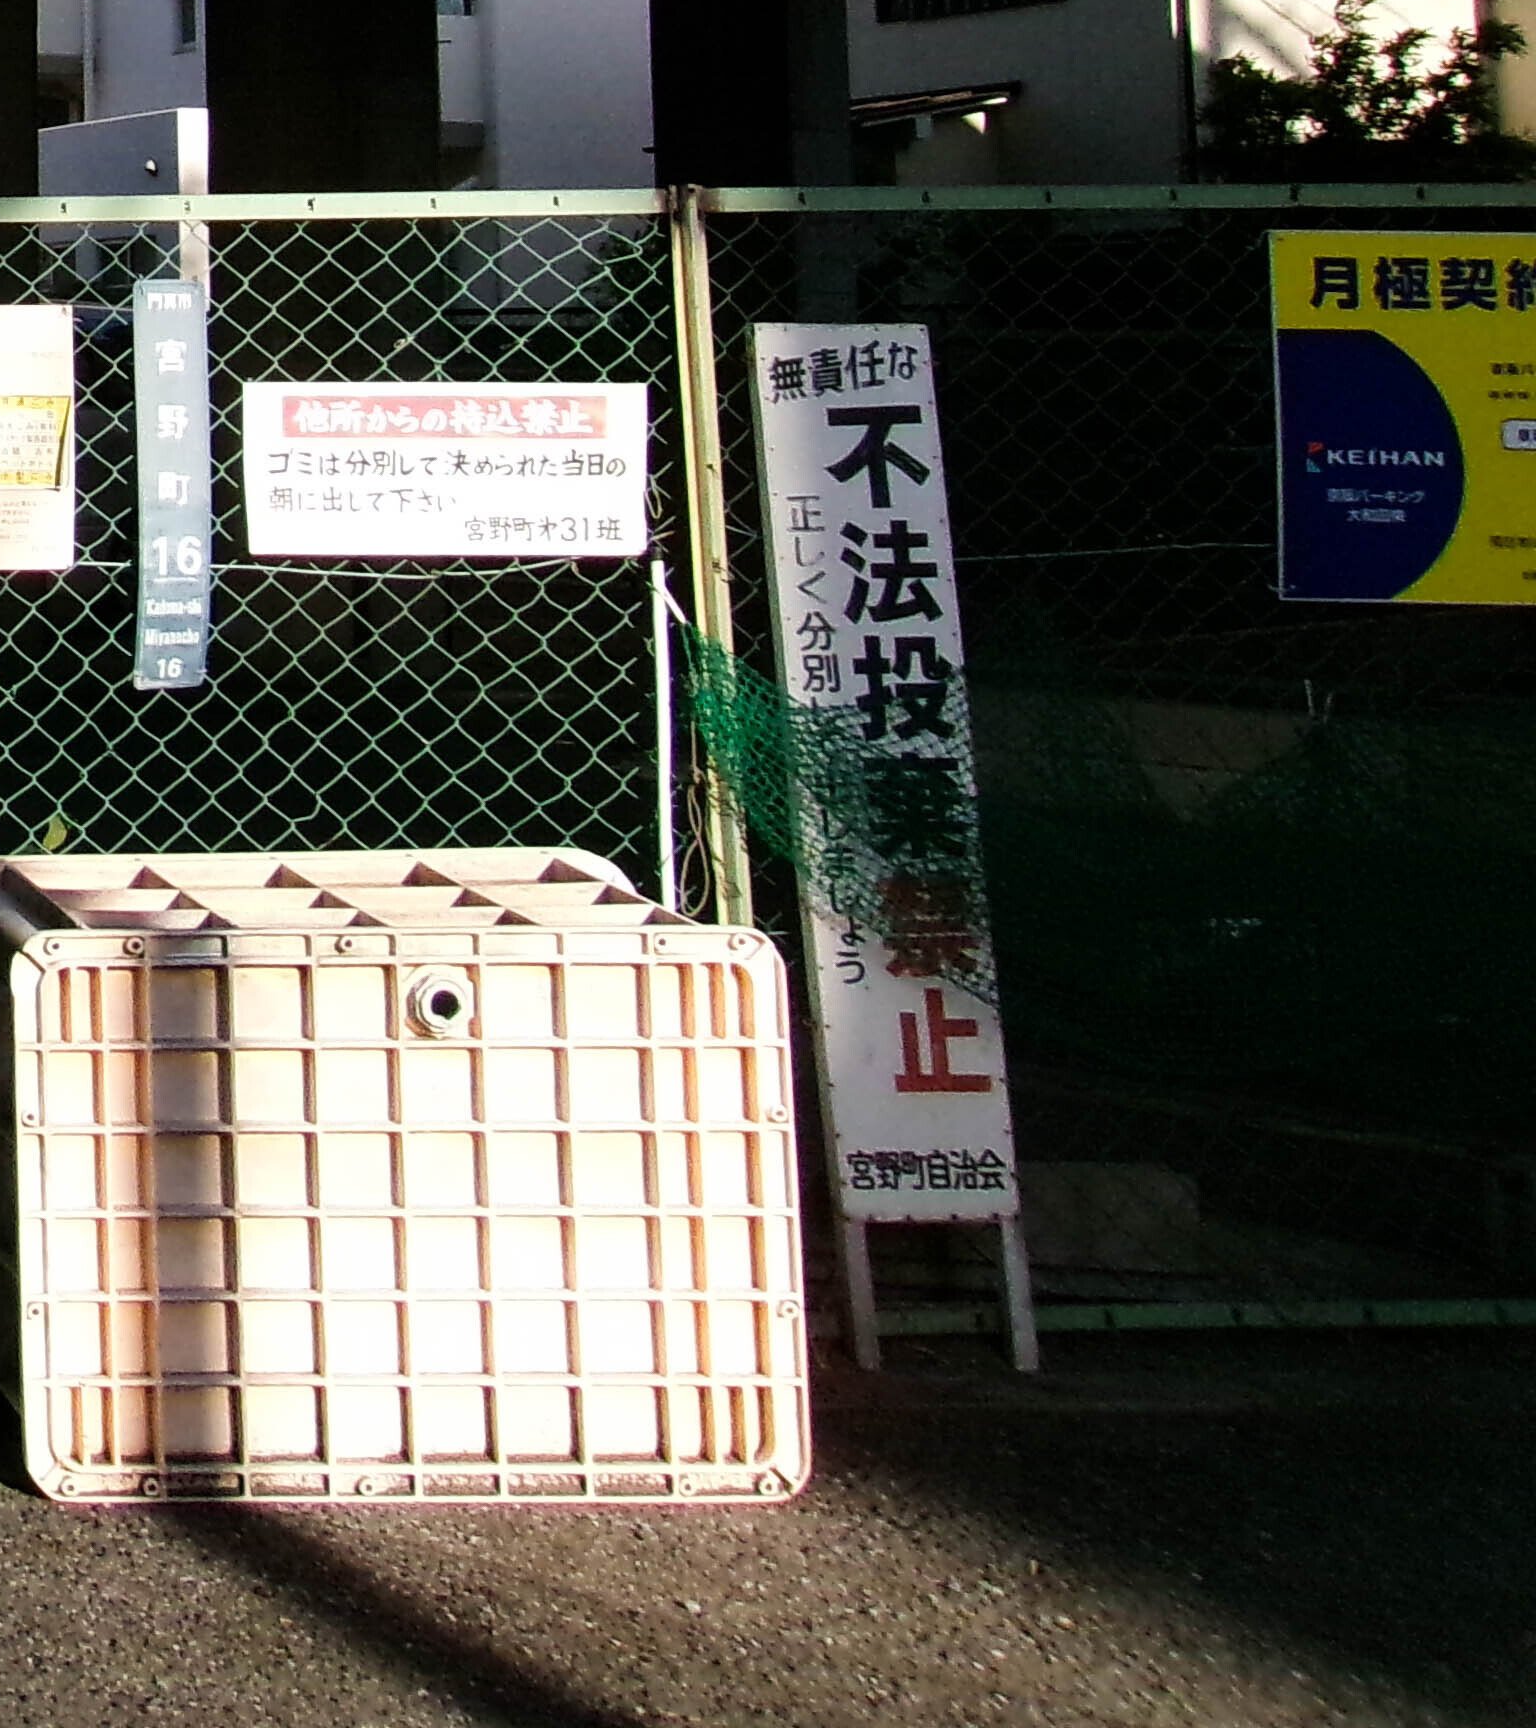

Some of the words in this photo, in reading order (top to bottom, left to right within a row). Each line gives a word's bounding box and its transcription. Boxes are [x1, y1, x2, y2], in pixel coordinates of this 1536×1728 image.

[769, 340, 919, 404] 無責任な
[293, 399, 594, 436] 他所からの持込禁止
[266, 448, 627, 478] ゴミは分別して決められた当日の
[1326, 448, 1446, 468] KEIHAN
[268, 486, 458, 513] 朝に出して下さい
[151, 535, 203, 576] 16
[156, 657, 184, 679] 16
[846, 1148, 1007, 1191] 宮野町自治会
